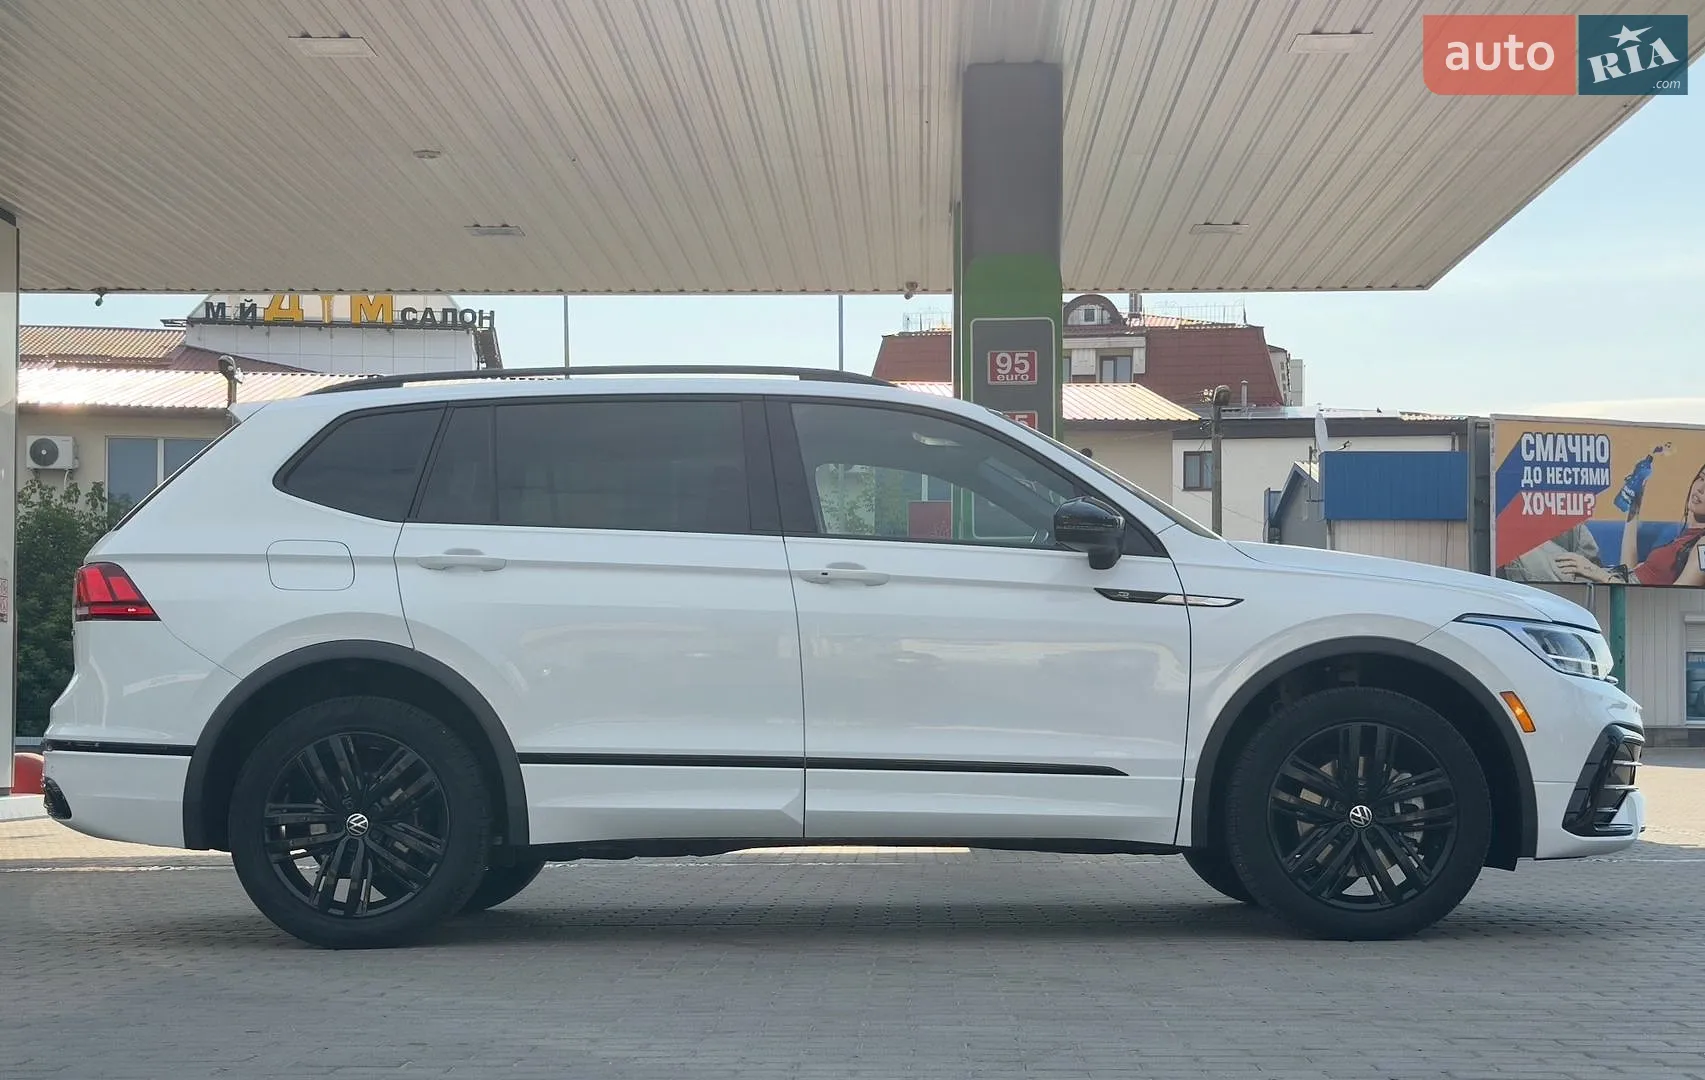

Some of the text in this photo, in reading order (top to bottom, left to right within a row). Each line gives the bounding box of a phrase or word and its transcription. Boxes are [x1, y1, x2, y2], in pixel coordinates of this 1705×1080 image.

[400, 307, 495, 328] САЛОН
[996, 352, 1030, 374] 95
[1521, 433, 1610, 463] СМАЧНО
[1521, 466, 1610, 488] ДО НЕСТЯМИ
[1521, 491, 1595, 516] ХОЧЕШ?
